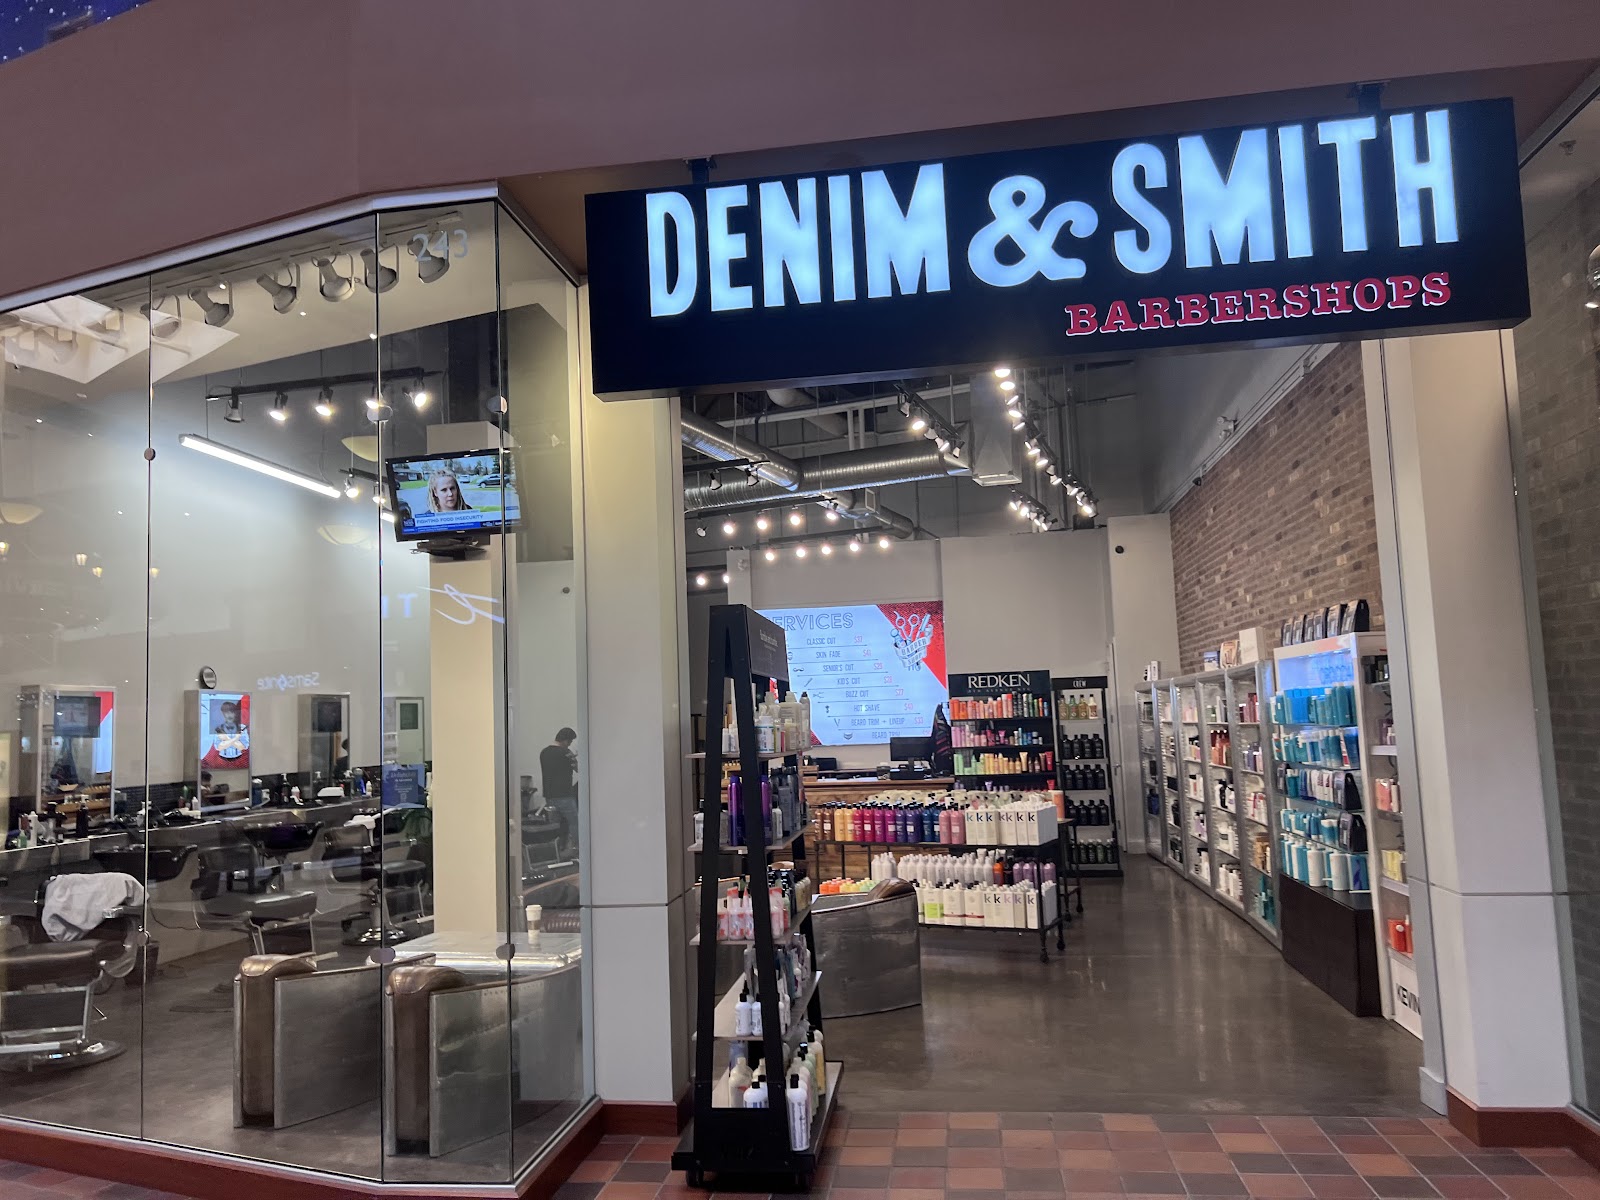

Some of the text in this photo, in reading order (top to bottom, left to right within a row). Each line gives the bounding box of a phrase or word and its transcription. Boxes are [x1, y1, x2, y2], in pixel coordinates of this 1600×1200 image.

[645, 109, 1459, 317] DENIM & SMITH
[412, 229, 469, 262] 243
[1064, 271, 1452, 337] BARBERSHOPS
[454, 514, 484, 522] INSECURITY
[771, 612, 854, 632] ERVICES
[806, 637, 826, 646] CLASSIC
[826, 637, 836, 645] CUT
[815, 651, 827, 659] SKIN
[829, 650, 841, 658] FADE
[823, 664, 843, 672] SENIOR'S
[844, 663, 854, 671] CUT
[837, 677, 849, 685] KID'S
[851, 677, 861, 685] CUT
[967, 673, 1031, 689] REDKEN
[845, 690, 858, 698] BUZZ
[859, 689, 869, 698] CUT
[853, 704, 863, 712] HOT
[864, 703, 880, 711] SHAVE
[851, 719, 867, 727] BEARD
[867, 718, 880, 726] TRIM
[889, 717, 905, 726] LINEUP
[871, 731, 887, 739] BEARD
[966, 812, 973, 822] k
[976, 812, 983, 822] k
[985, 812, 993, 822] k
[1006, 812, 1013, 822] k
[1016, 811, 1024, 822] k
[1028, 811, 1035, 822] k
[984, 893, 991, 904] k
[994, 893, 1001, 904] k
[1004, 893, 1011, 904] k
[1014, 893, 1022, 904] k
[1027, 894, 1035, 905] k
